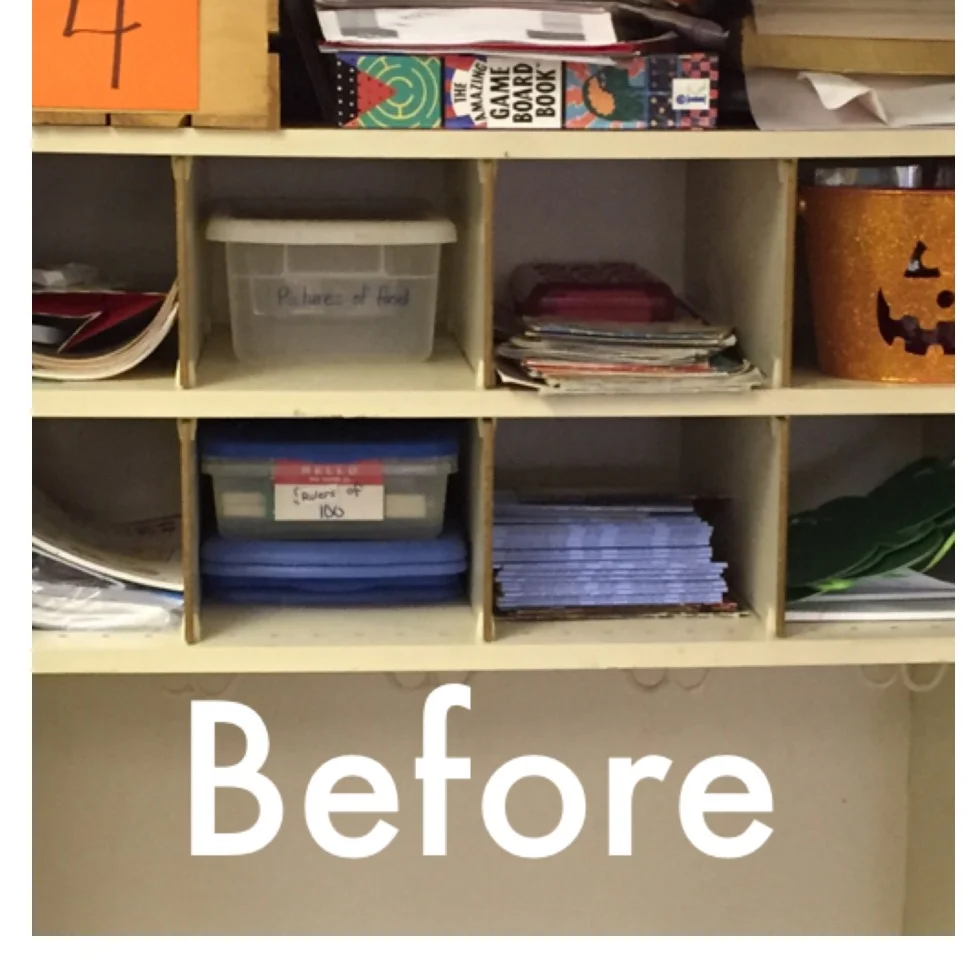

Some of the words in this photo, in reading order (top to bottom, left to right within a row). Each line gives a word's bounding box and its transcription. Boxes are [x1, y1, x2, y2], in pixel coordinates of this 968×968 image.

[454, 82, 467, 103] THE
[470, 61, 487, 121] AMAZING
[490, 67, 511, 119] GAME
[512, 63, 533, 123] BOARD
[535, 69, 556, 117] BOOK
[352, 285, 368, 306] of
[320, 503, 345, 519] 100
